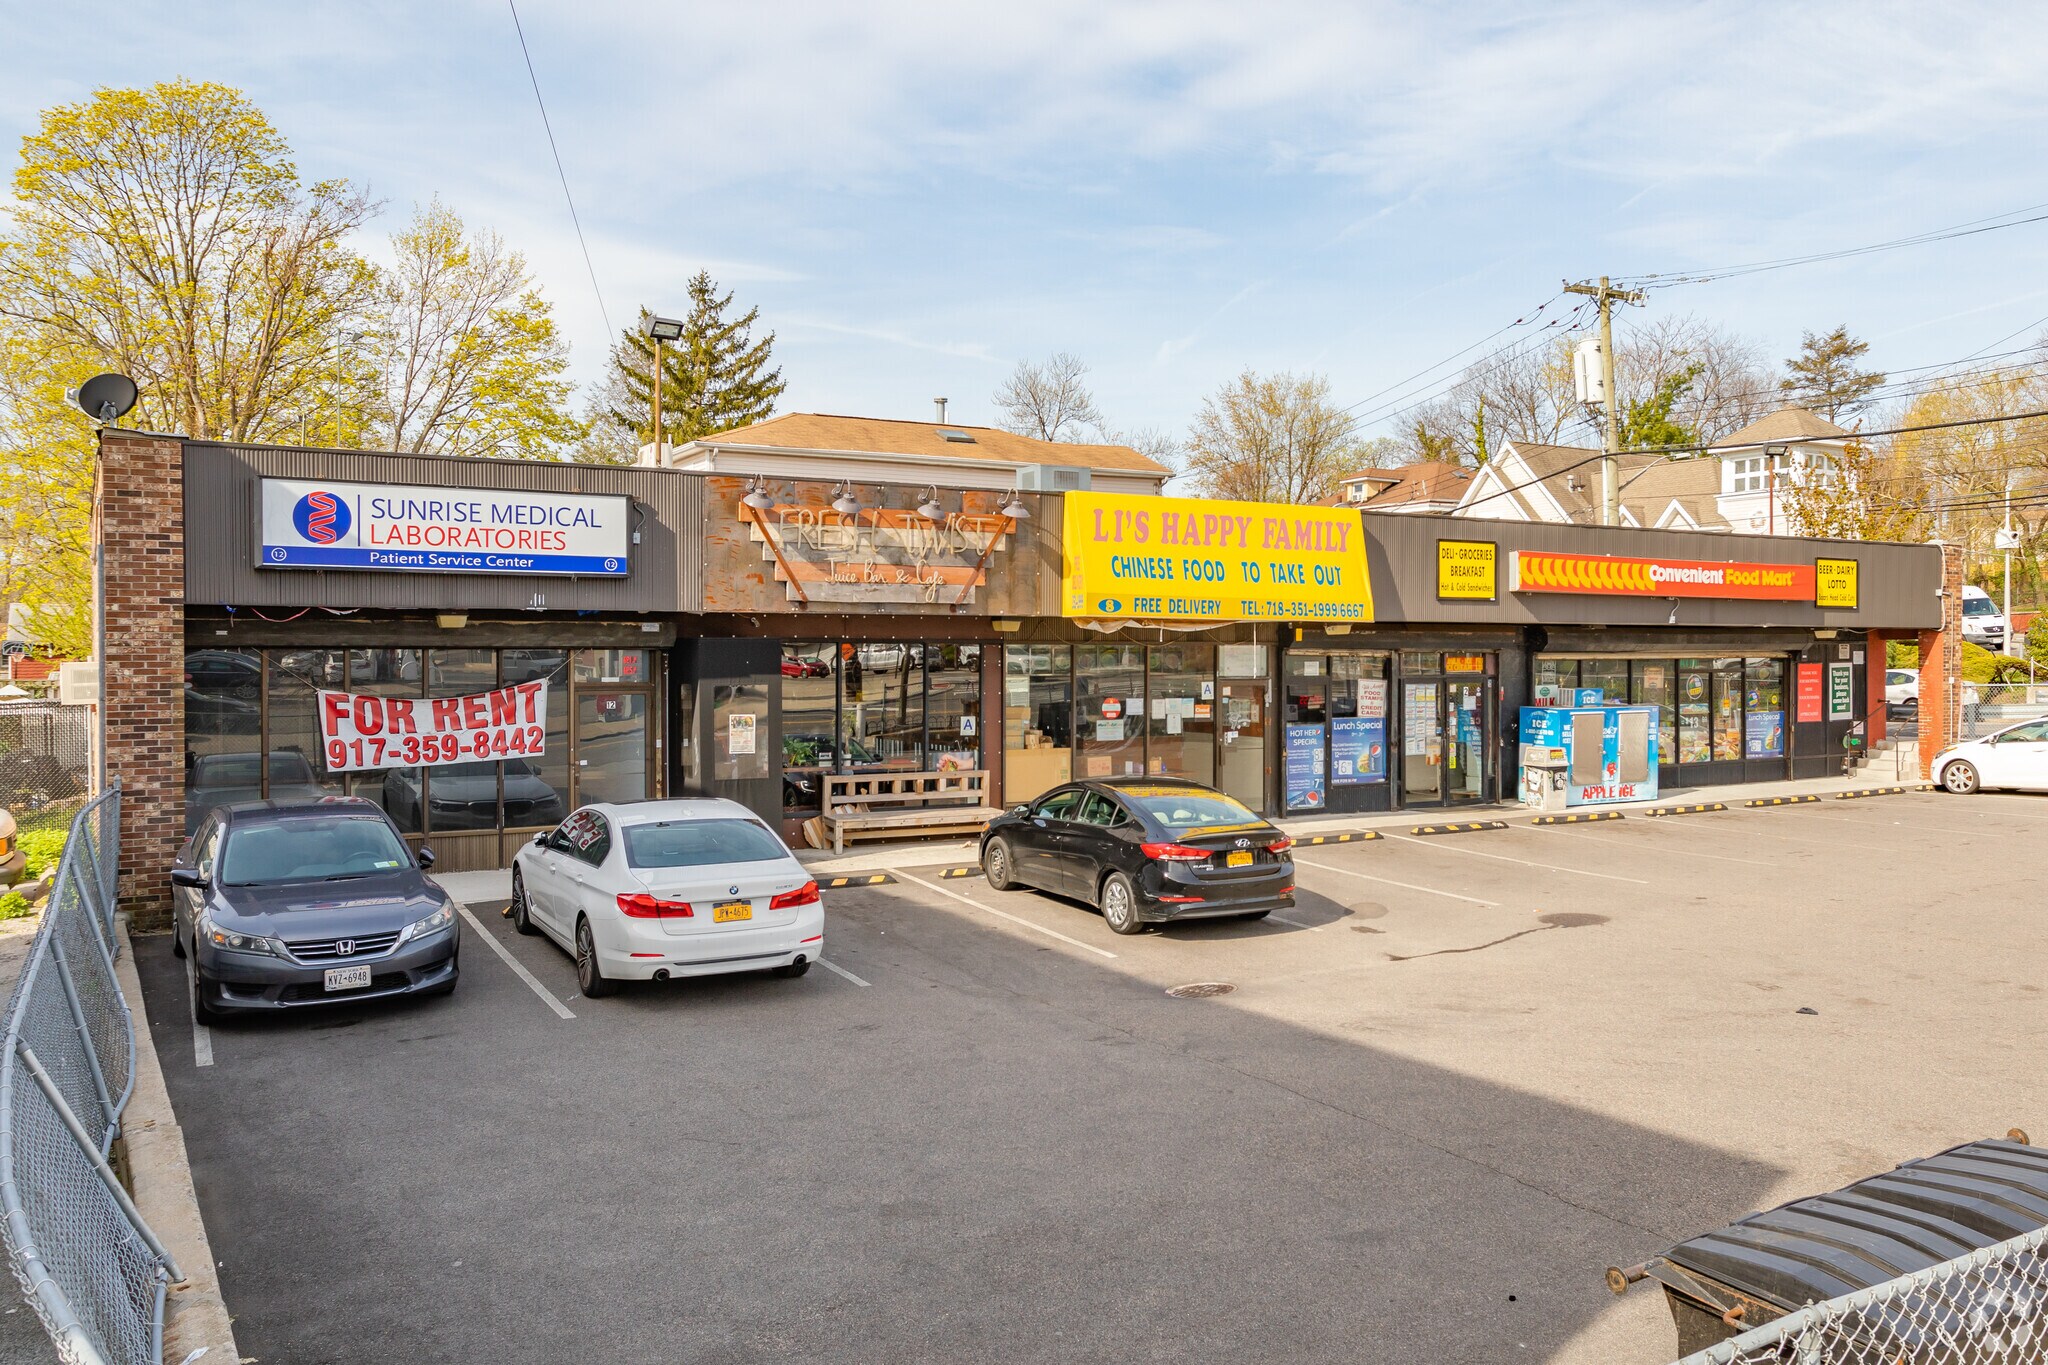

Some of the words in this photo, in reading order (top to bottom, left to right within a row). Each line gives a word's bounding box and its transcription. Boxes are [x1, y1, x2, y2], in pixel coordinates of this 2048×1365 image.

[370, 498, 482, 523] SUNRISE
[492, 503, 602, 528] MEDICAL
[370, 523, 567, 551] LABORATORIES
[779, 508, 879, 553] FRESH
[896, 511, 995, 557] TWIST
[1093, 508, 1149, 543] LI'S
[1161, 512, 1253, 548] HAPPY
[1262, 518, 1352, 553] FAMILY
[274, 550, 284, 559] 12
[370, 552, 425, 566] Patient
[428, 554, 482, 567] Service
[486, 555, 534, 568] Center
[607, 560, 616, 569] 12
[825, 556, 857, 584] Juice
[863, 558, 887, 584] Bar
[895, 569, 909, 584] &
[1111, 555, 1174, 580] CHINESE
[1182, 559, 1226, 583] FOOD
[1241, 561, 1261, 584] TO
[1270, 563, 1306, 585] TAKE
[1314, 564, 1342, 587] OUT
[1450, 565, 1485, 578] BREAKFAST
[1648, 563, 1724, 585] Convenient
[1725, 568, 1760, 587] Food
[1762, 570, 1793, 587] Mart
[1827, 579, 1847, 590] LOTTO
[1104, 599, 1115, 613] 8
[1133, 597, 1162, 614] FREE
[1169, 598, 1222, 615] DELIVERY
[1203, 683, 1212, 695] A
[606, 701, 616, 709] 12
[1535, 697, 1555, 707] MILK
[1582, 696, 1596, 704] ICE
[324, 693, 417, 737] FOR
[432, 683, 543, 733] RENT
[1532, 719, 1548, 729] ICE
[1748, 714, 1762, 722] Lunch
[1762, 713, 1780, 721] Special
[963, 718, 973, 731] A
[1333, 721, 1355, 731] Lunch
[1356, 720, 1383, 732] Special
[1289, 729, 1303, 737] HOT
[328, 726, 544, 769] 917-359-8442
[1293, 738, 1317, 746] SPECIAL
[1582, 784, 1616, 800] APPLE
[328, 970, 367, 986] KVZ-6948
